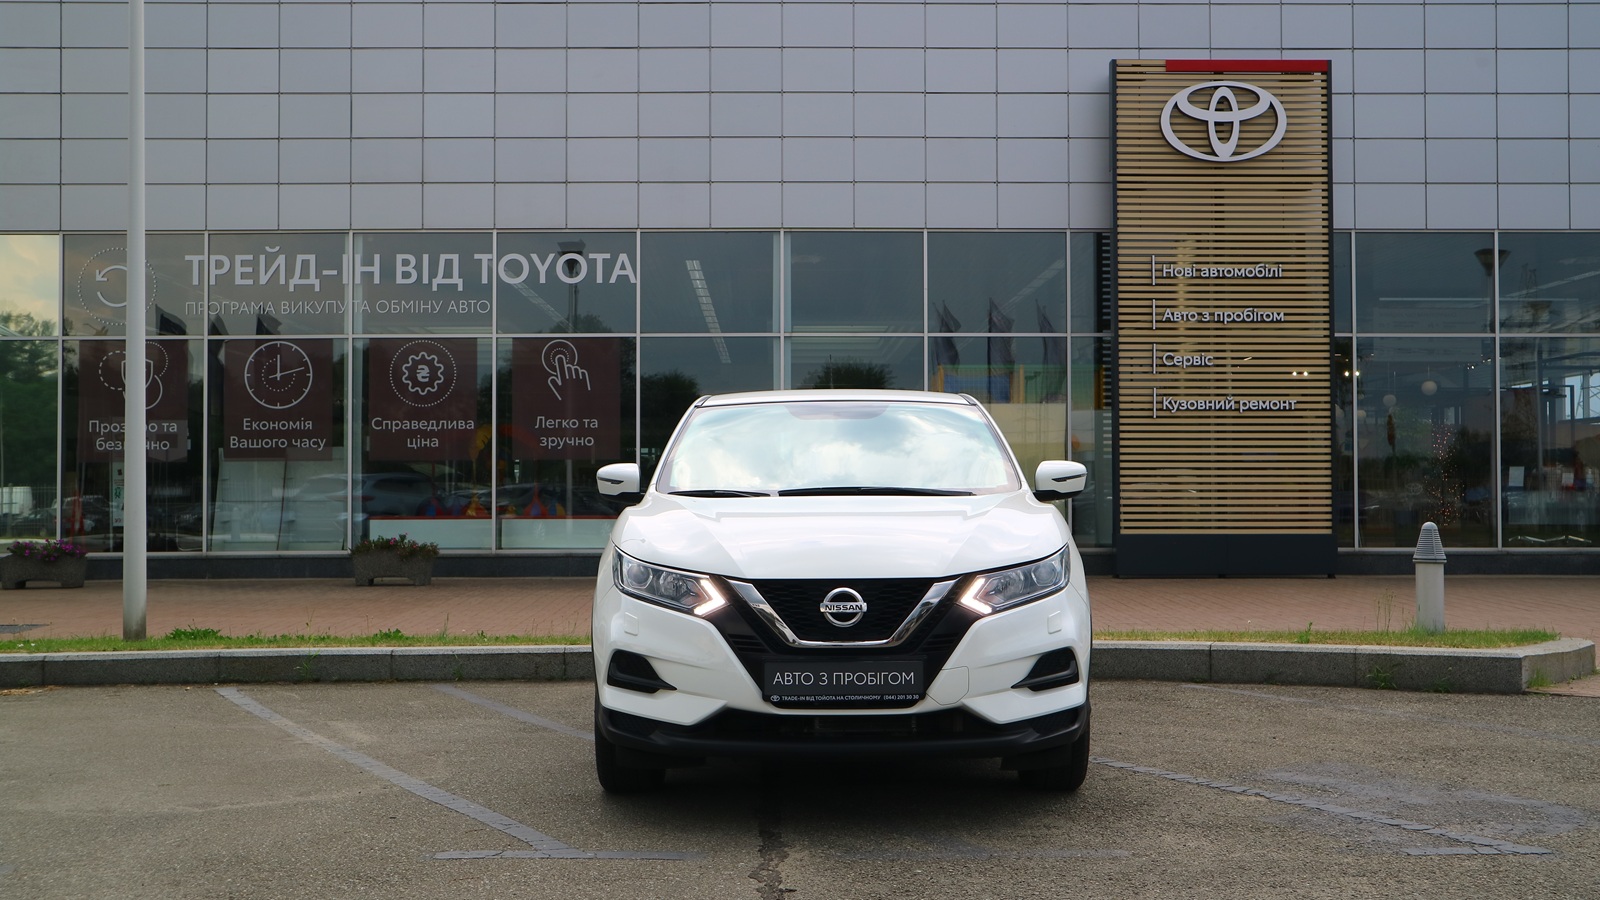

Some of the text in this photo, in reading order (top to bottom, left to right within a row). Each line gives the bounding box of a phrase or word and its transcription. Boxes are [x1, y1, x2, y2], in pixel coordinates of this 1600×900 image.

[184, 245, 381, 292] ТРЕЙД-ІН
[395, 253, 463, 291] ВІД
[1162, 263, 1283, 278] Нові автомобілі
[185, 300, 491, 315] ПРОГРАМА ВИКУПУ ТА ОБМІНУ АВТО
[1162, 308, 1284, 324] Авто з пробігом
[1162, 352, 1214, 368] Сервіс
[1162, 396, 1297, 413] Кузовний ремонт
[161, 422, 178, 432] та
[243, 418, 313, 430] Економія
[371, 417, 475, 433] Справедлива
[535, 416, 598, 429] Легко та
[230, 436, 326, 451] Вашого часу
[407, 435, 439, 449] ціна
[540, 436, 594, 449] зручно
[773, 672, 814, 685] АВТО
[833, 672, 915, 685] ПРОБІГОМ
